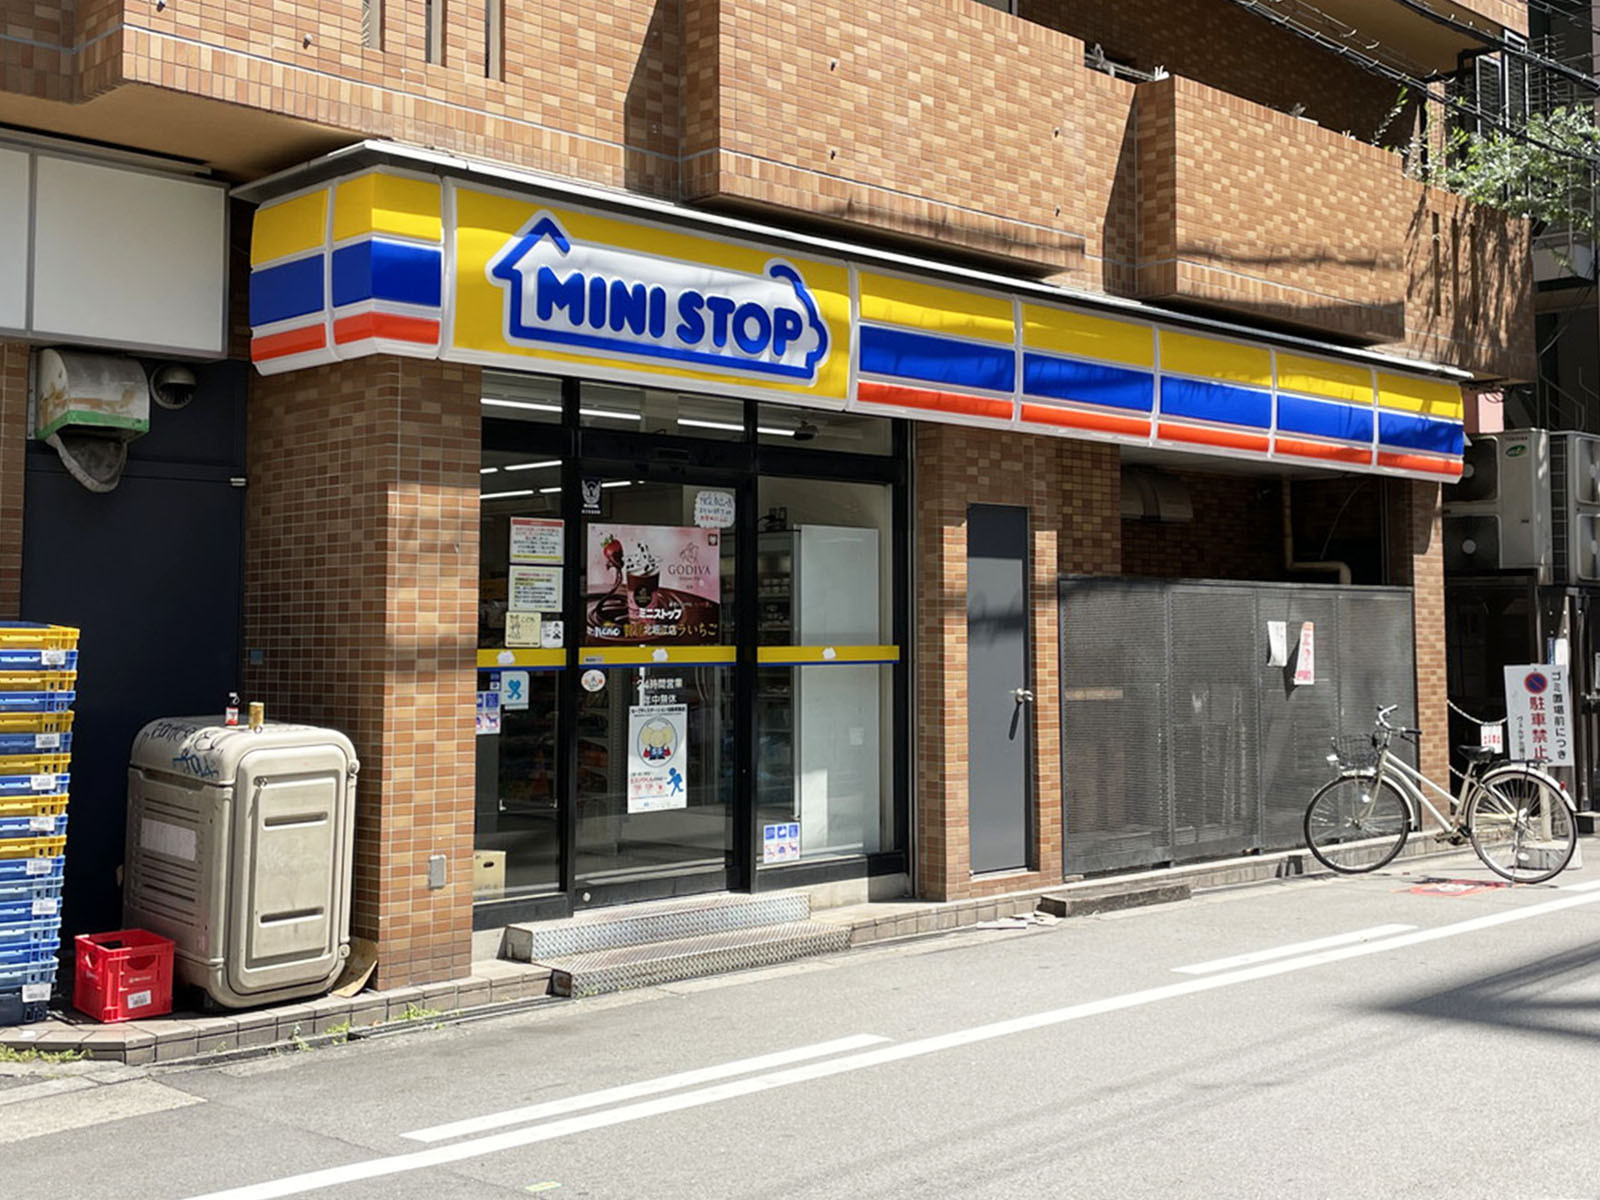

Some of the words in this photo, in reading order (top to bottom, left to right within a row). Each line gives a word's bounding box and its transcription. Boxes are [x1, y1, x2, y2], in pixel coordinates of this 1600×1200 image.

[537, 266, 666, 339] MINI
[676, 290, 803, 357] STOP
[667, 564, 711, 576] GODIVA
[638, 607, 682, 620] ミニストップ
[636, 677, 683, 690] 24時間営業
[1529, 696, 1550, 761] 駐車禁止
[1551, 671, 1568, 760] ゴミ置場前につき
